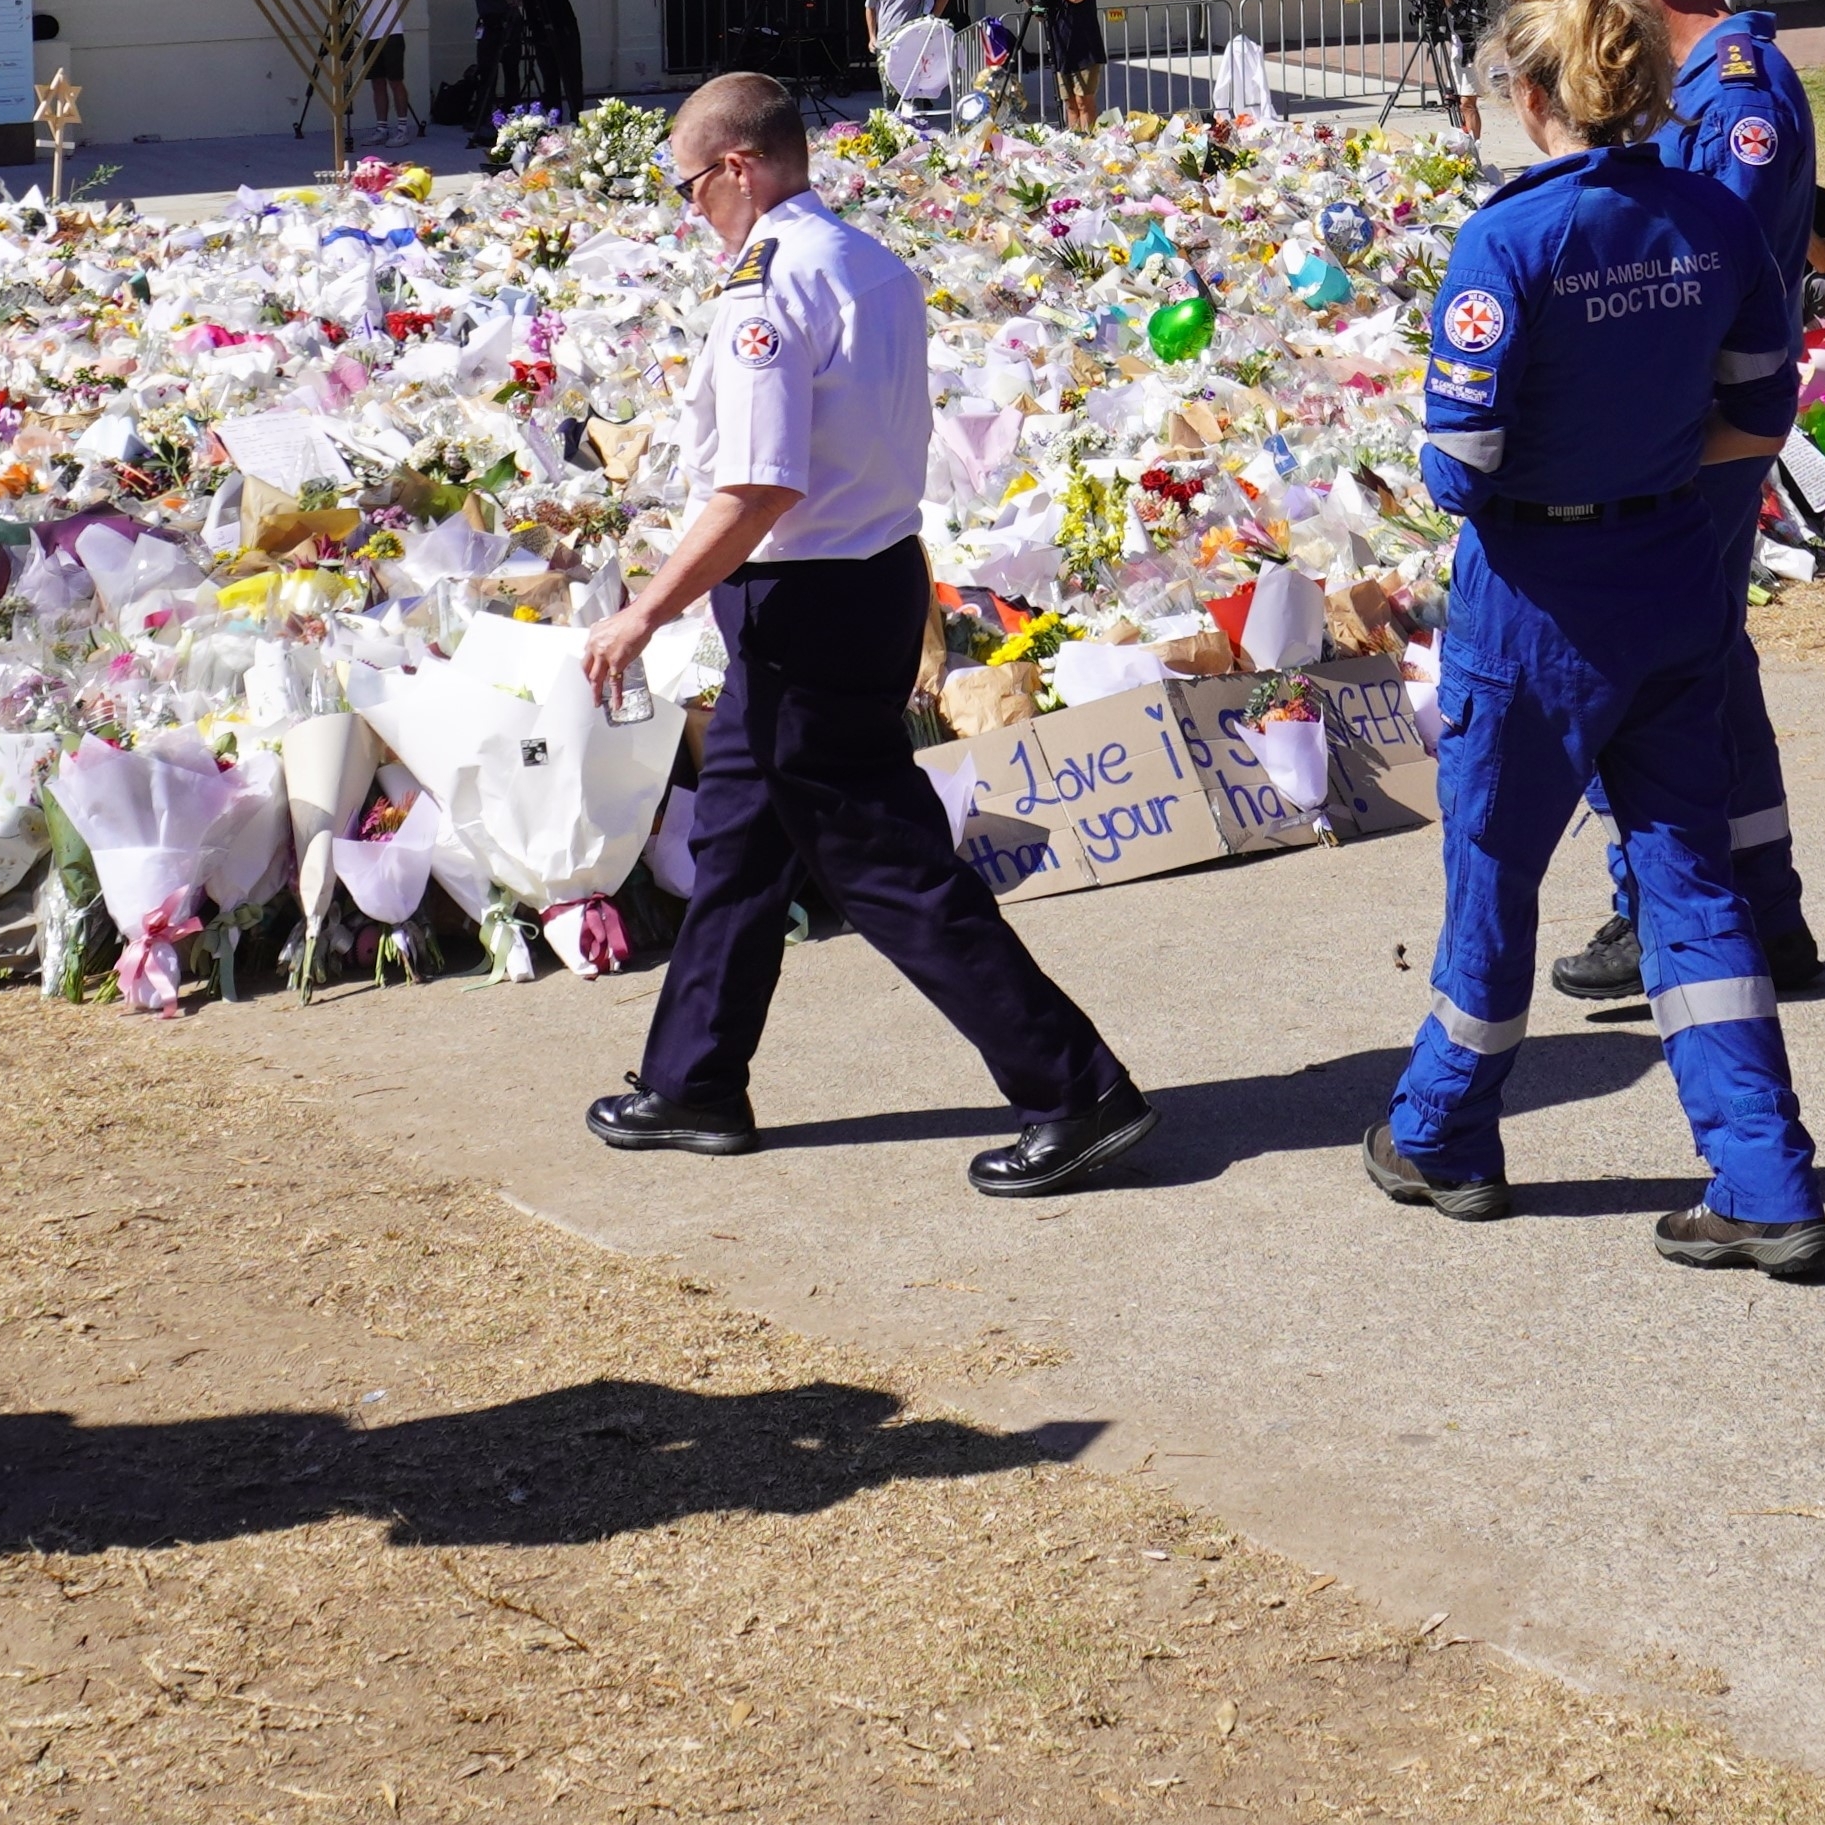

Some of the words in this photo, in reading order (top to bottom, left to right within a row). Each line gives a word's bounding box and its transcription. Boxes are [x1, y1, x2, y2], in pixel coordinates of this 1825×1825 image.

[1553, 270, 1600, 297] NSW
[1606, 252, 1721, 286] AMBULANCE
[1586, 280, 1702, 323] DOCTOR
[1547, 503, 1594, 517] summit
[1009, 739, 1133, 816] Love
[968, 835, 1060, 887] than
[1079, 794, 1180, 864] your
